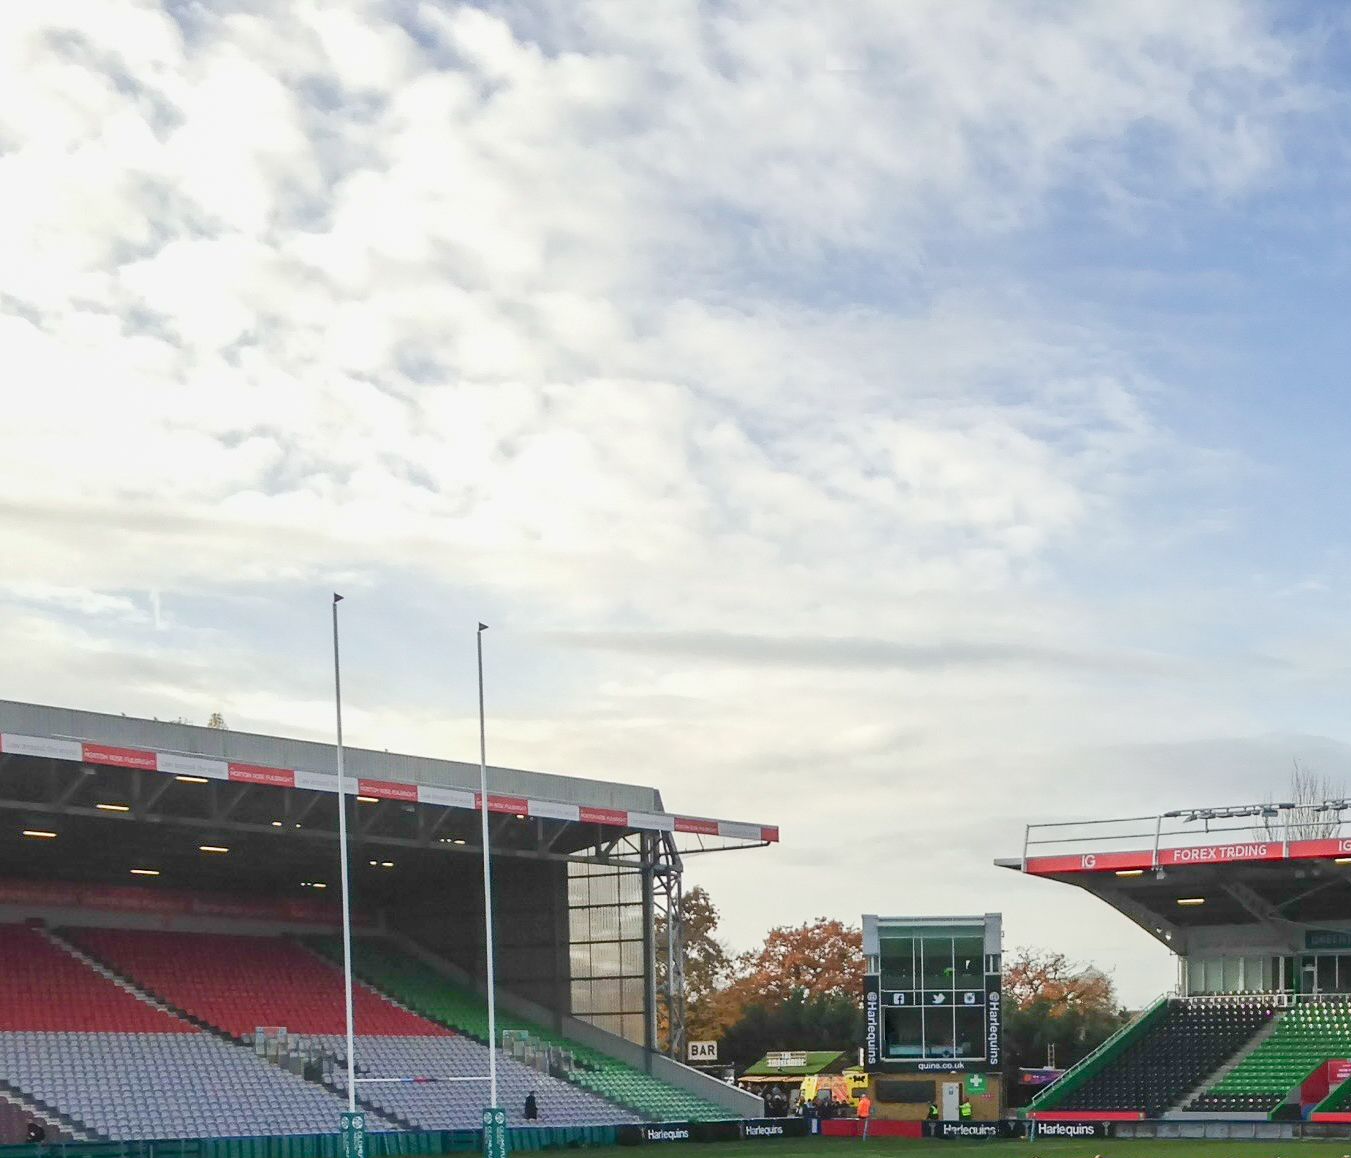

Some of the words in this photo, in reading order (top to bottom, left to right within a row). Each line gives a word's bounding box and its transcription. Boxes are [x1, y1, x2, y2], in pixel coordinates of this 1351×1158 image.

[1174, 846, 1216, 861] FOREX
[1080, 854, 1096, 868] IG
[691, 1045, 716, 1058] BAR
[648, 1129, 688, 1141] Harlequins
[746, 1125, 783, 1136] Harlequins
[1038, 1122, 1095, 1136] Harlequins
